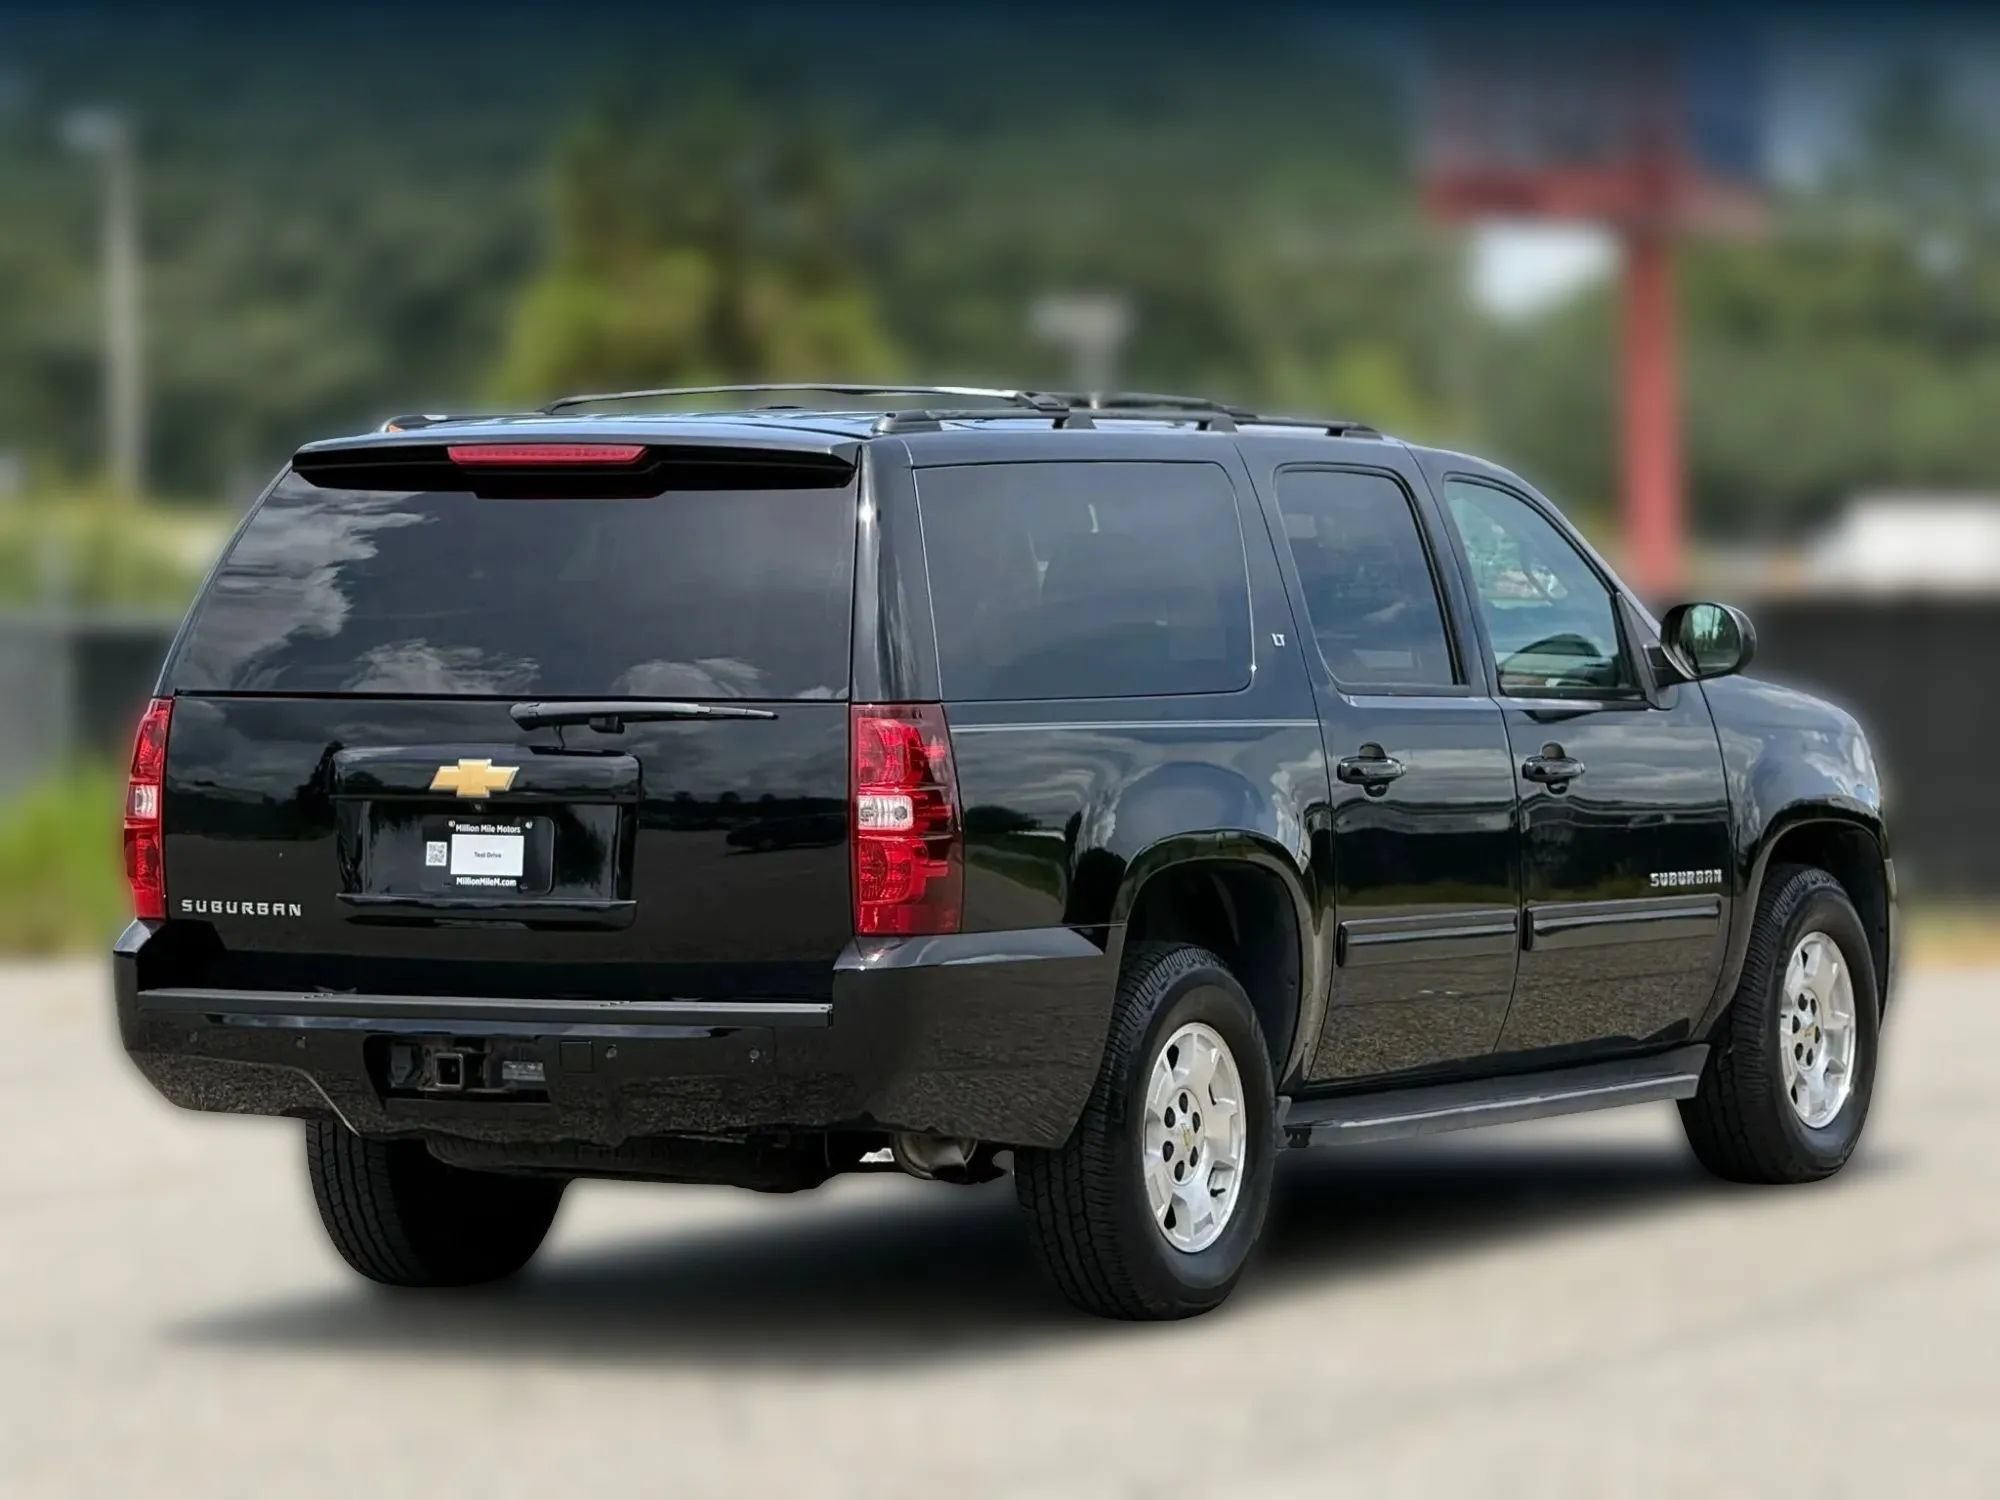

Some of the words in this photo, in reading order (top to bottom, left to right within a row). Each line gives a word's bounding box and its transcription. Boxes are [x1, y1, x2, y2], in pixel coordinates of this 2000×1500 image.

[1271, 633, 1285, 646] LT
[456, 824, 479, 832] Million
[481, 825, 496, 833] Mile
[497, 825, 521, 833] Motors
[456, 877, 517, 887] MillionMileM.com
[1649, 868, 1722, 887] SUBURBAN
[181, 899, 302, 917] SUBURBAN
